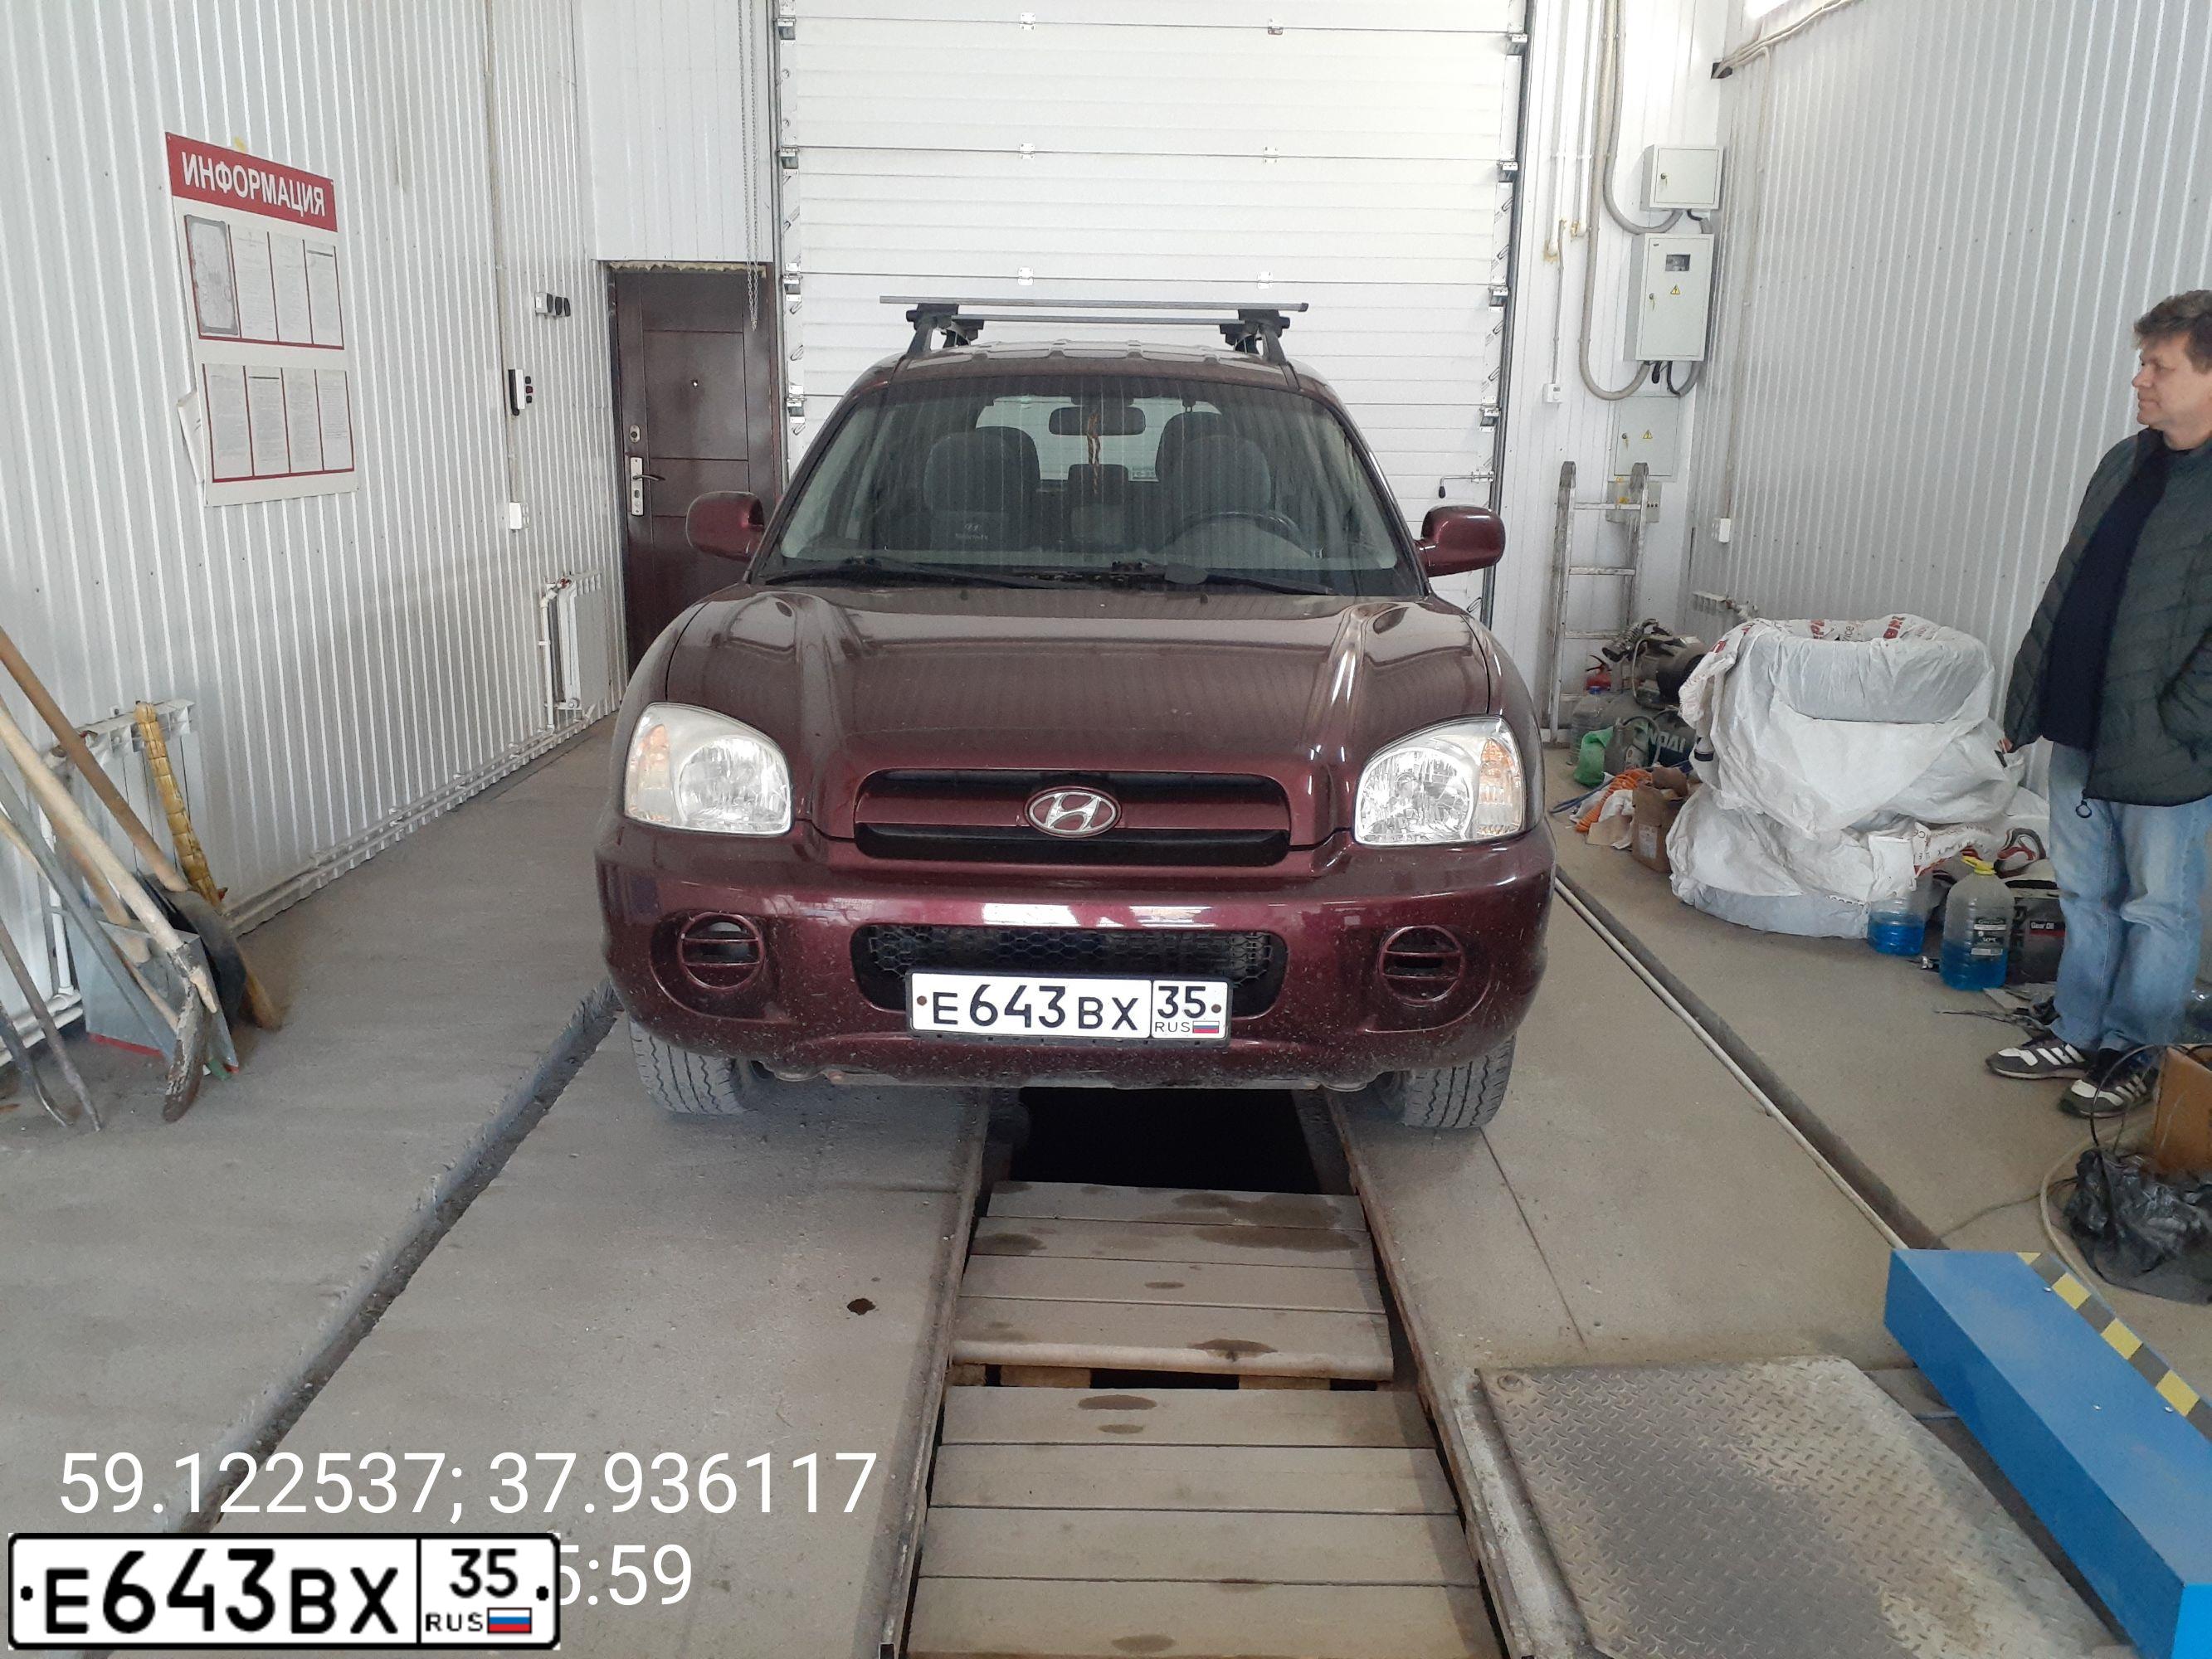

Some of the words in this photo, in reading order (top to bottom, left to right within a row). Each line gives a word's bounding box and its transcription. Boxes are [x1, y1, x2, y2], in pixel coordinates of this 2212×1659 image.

[181, 151, 326, 217] ИНФОРМАЦИЯ
[1157, 985, 1207, 1019] 35
[1154, 1020, 1191, 1034] RUS
